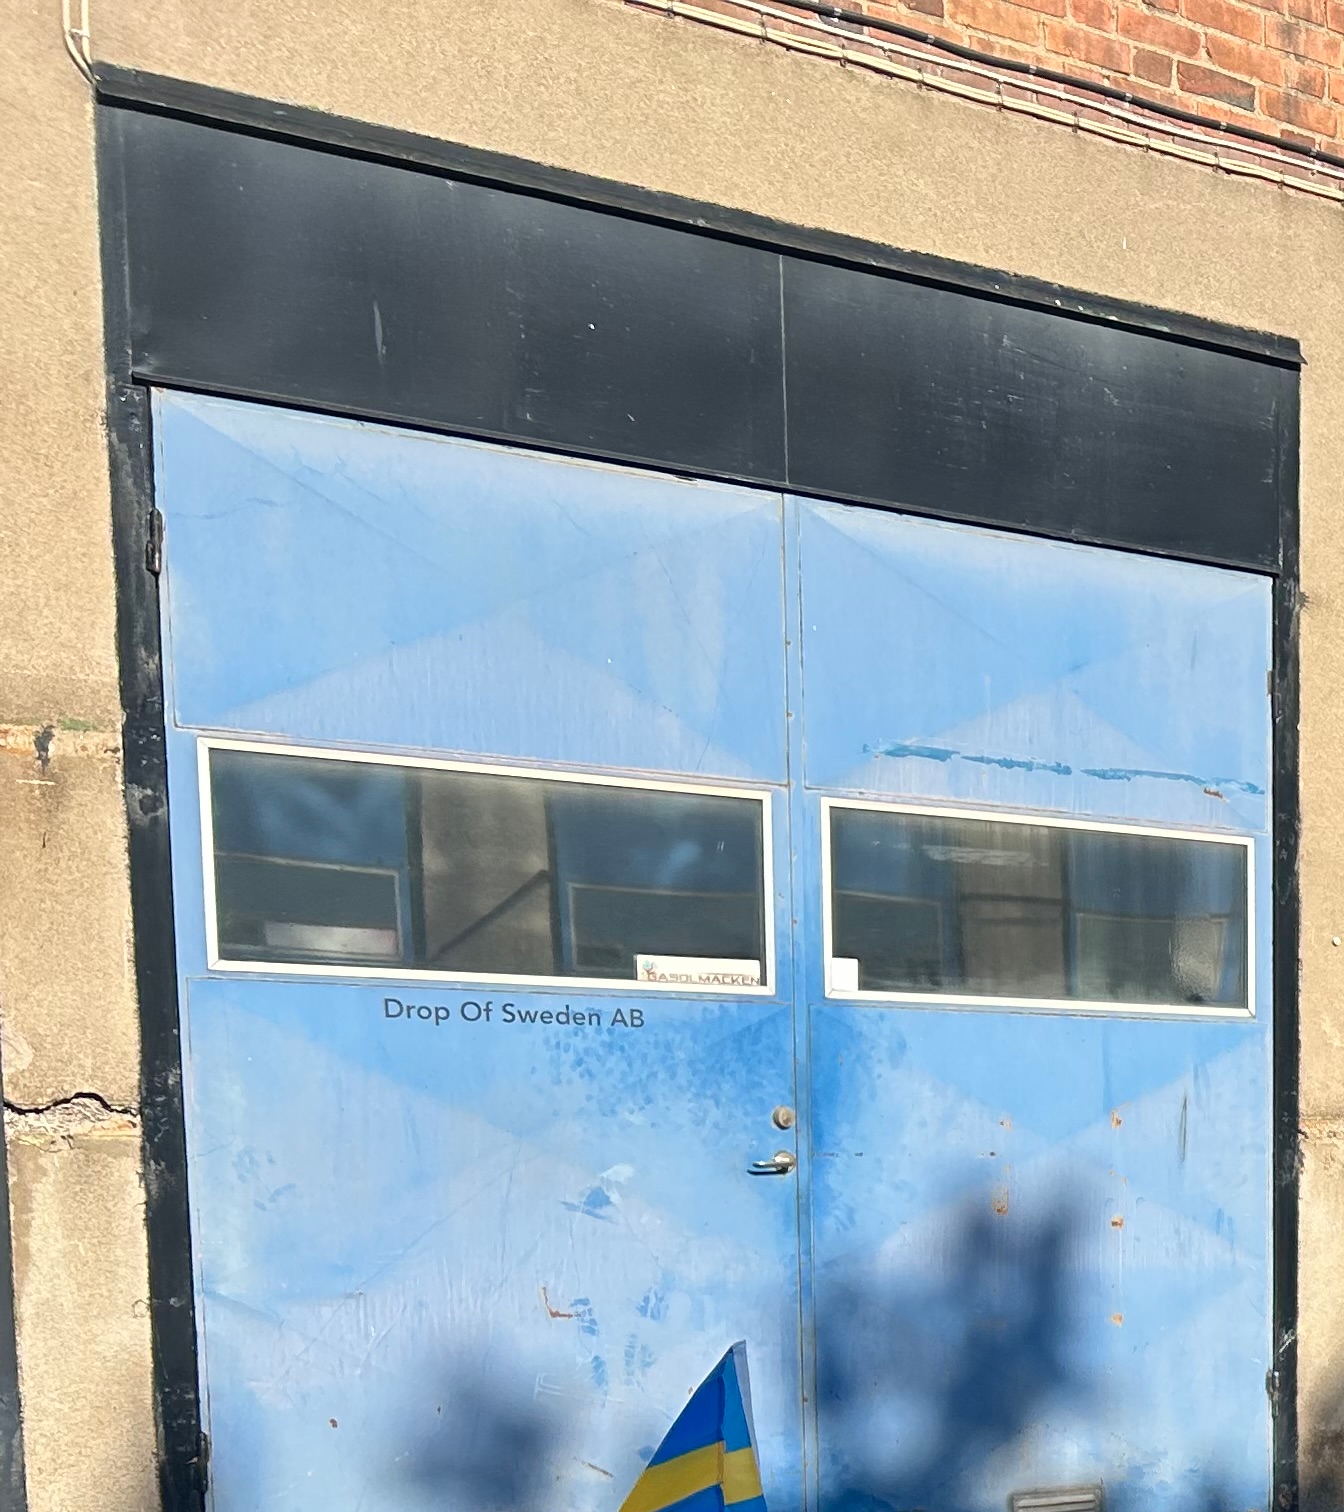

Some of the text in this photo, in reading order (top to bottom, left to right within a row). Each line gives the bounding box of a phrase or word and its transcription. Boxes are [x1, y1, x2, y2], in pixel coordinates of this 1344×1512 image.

[384, 998, 645, 1028] Drop Of Sweden AB
